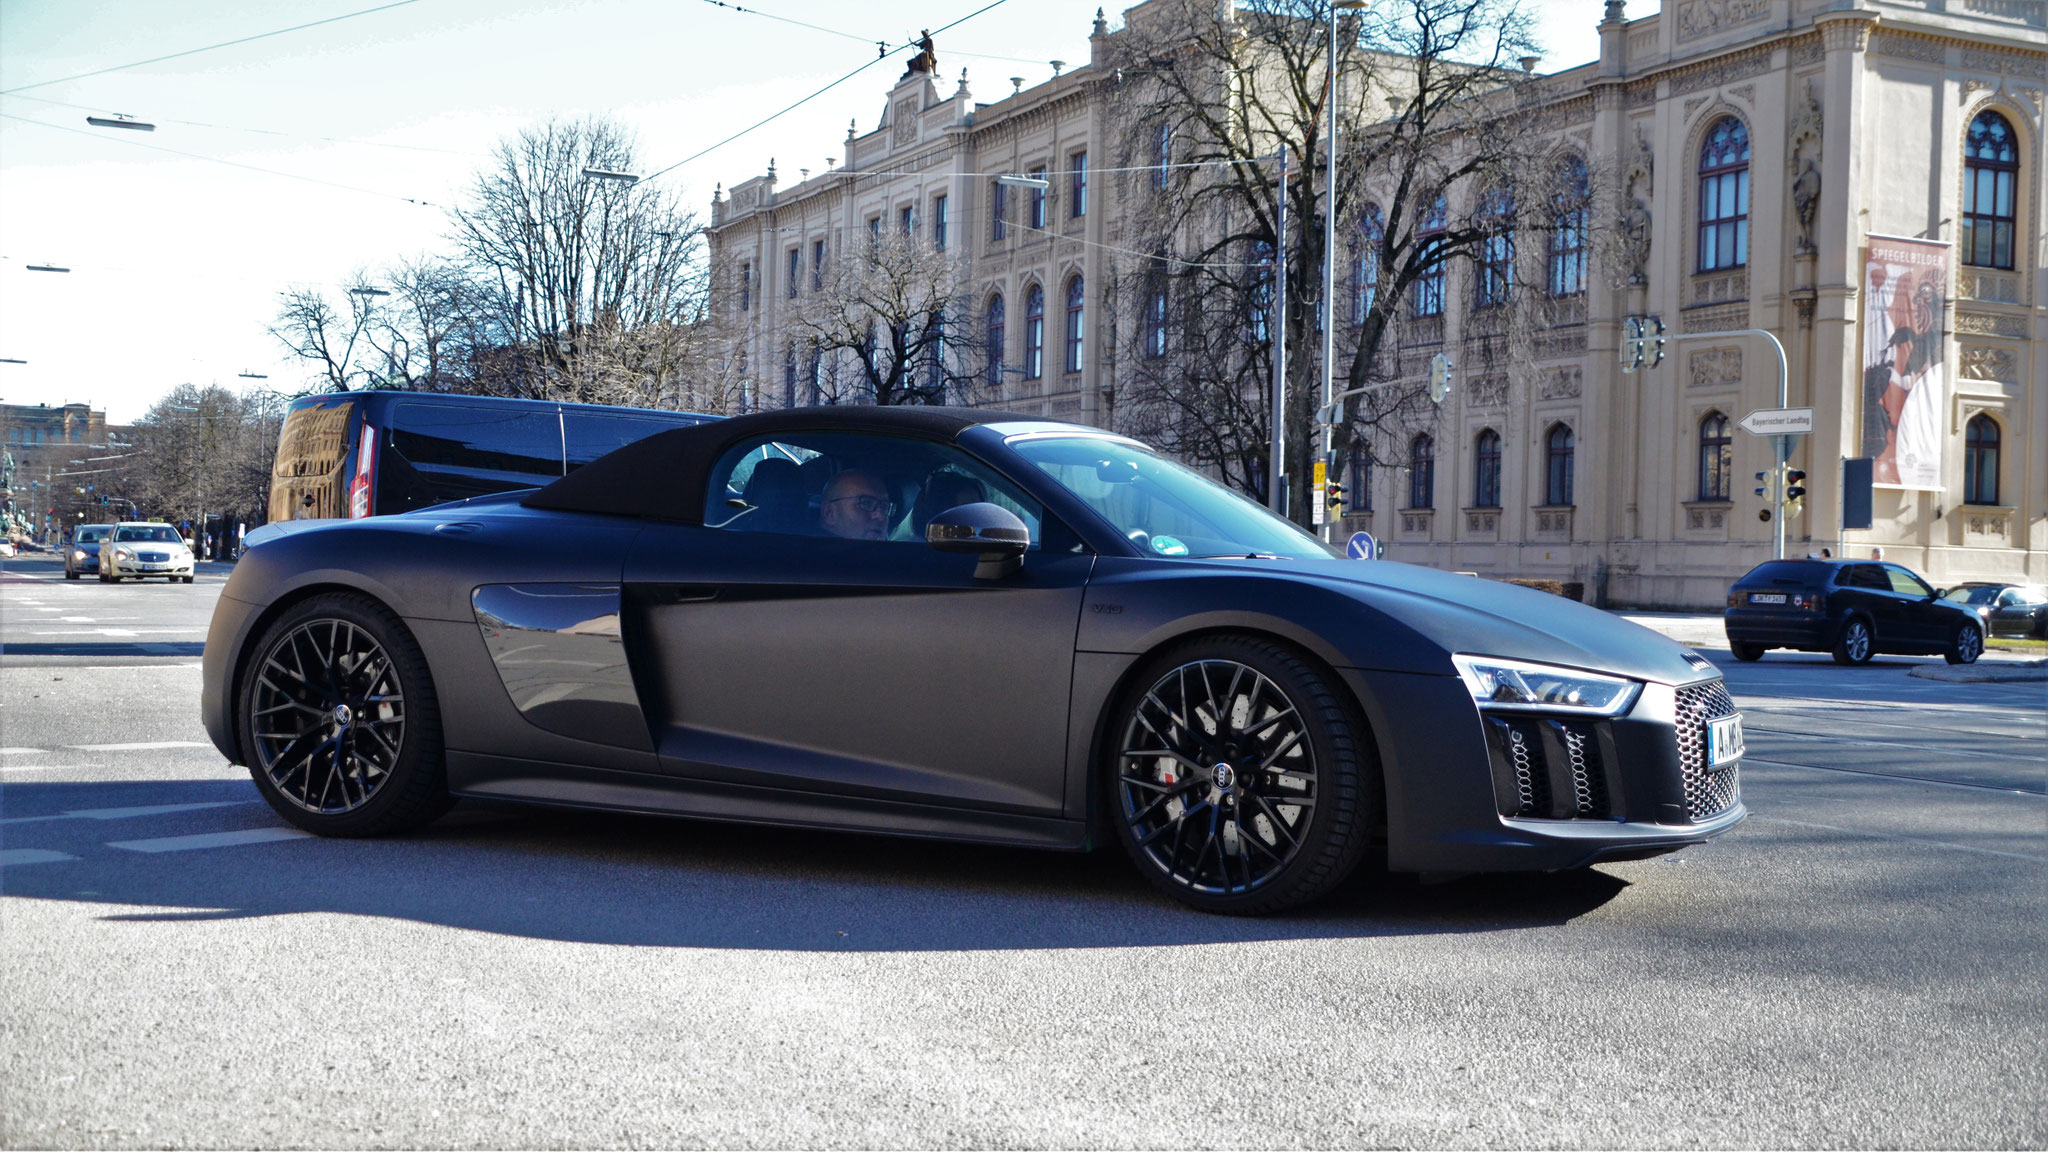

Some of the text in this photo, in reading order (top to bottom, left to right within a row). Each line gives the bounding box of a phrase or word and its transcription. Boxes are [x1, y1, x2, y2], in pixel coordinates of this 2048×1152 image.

[1872, 248, 1943, 267] SPIEGELBILDER
[1752, 415, 1810, 427] Bayerischer Landtag
[1092, 603, 1123, 615] V10
